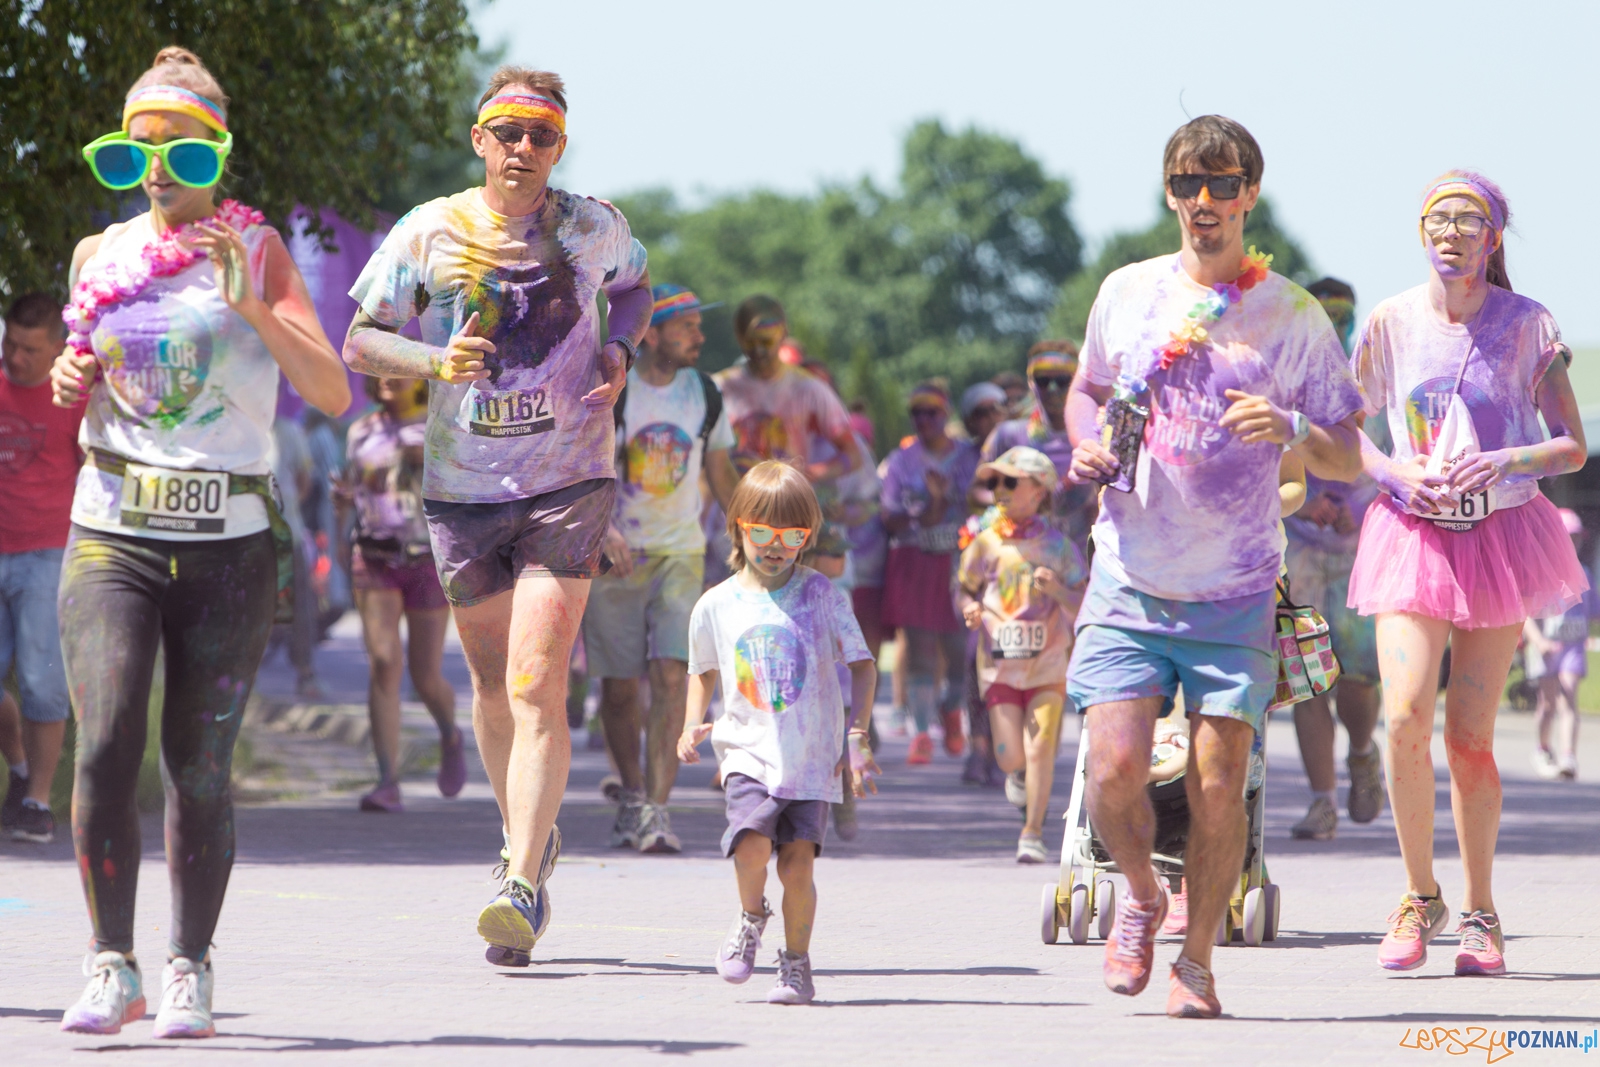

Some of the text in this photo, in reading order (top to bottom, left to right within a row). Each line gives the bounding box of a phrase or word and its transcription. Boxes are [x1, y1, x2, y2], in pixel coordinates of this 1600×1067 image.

[475, 389, 549, 422] 10162
[1425, 392, 1453, 419] TH
[490, 426, 532, 436] #HAPPIEST5K
[1155, 414, 1198, 451] RUN
[133, 474, 221, 514] 11880
[997, 625, 1044, 648] 10319
